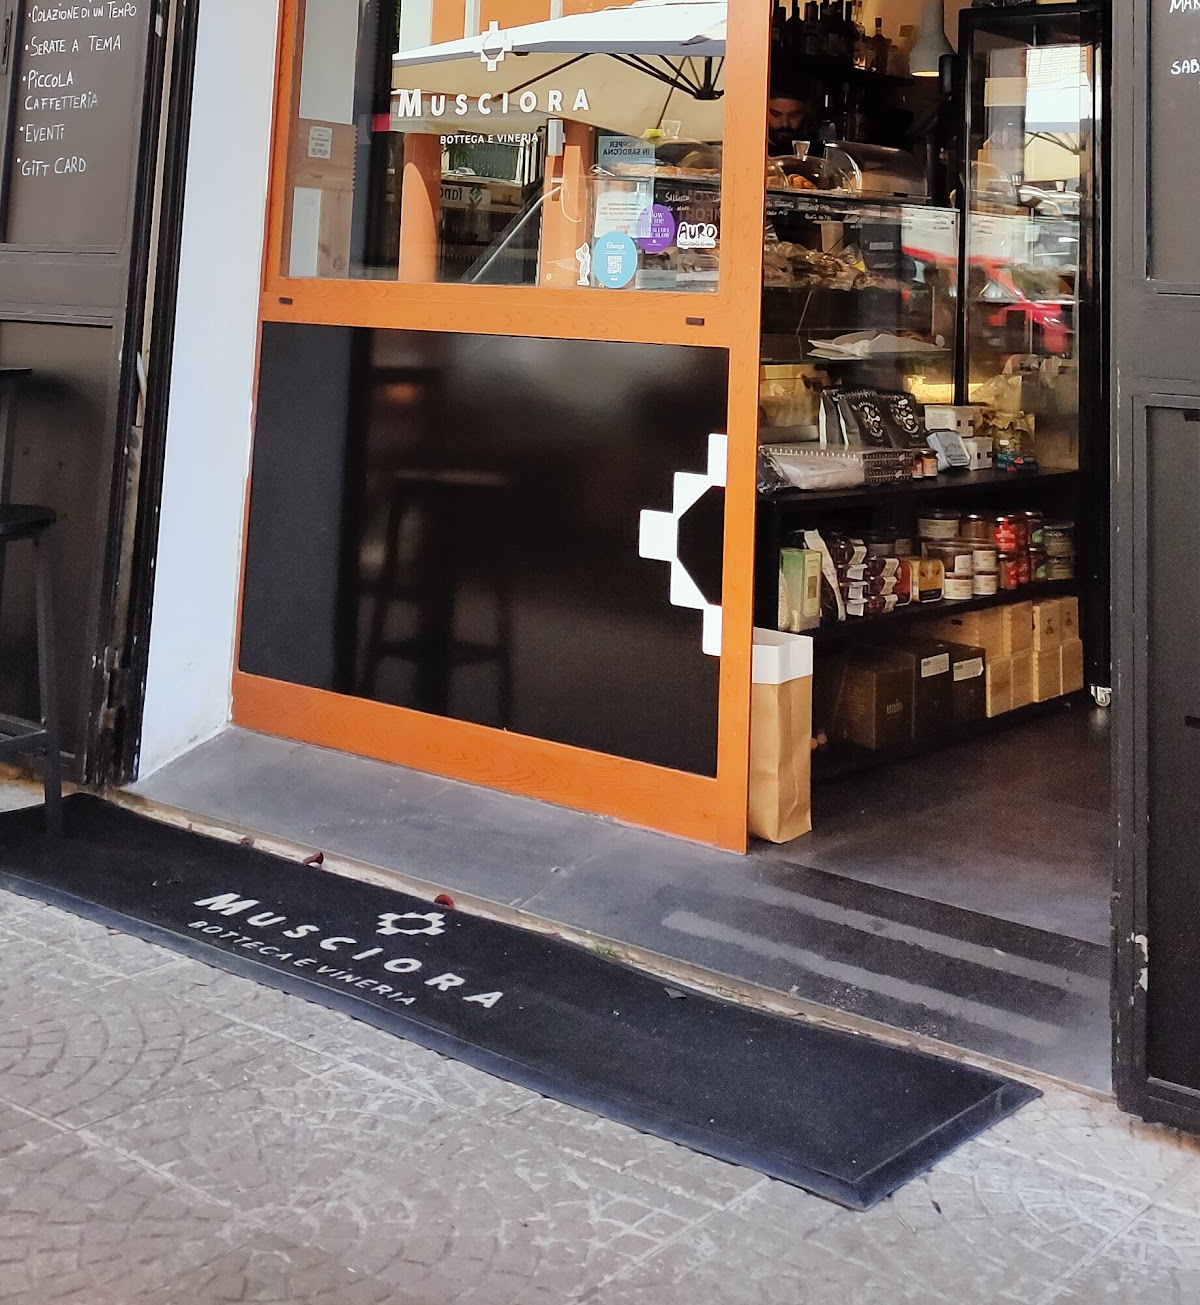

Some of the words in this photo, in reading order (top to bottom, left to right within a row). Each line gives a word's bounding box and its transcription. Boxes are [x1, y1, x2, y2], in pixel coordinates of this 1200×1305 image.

[93, 6, 103, 18] UN
[107, 0, 137, 19] TEMPO
[30, 36, 66, 57] SERATE
[71, 38, 79, 52] A
[88, 34, 121, 53] TEMA
[397, 88, 591, 118] MUSCIORA
[440, 133, 485, 145] BOTTEGA
[488, 134, 494, 144] E
[497, 132, 539, 144] VINERIA
[54, 156, 86, 174] CARD
[679, 224, 716, 239] AURO
[193, 892, 503, 1008] MUSCIORA
[292, 958, 318, 967] E
[316, 964, 416, 1007] VINERIA
